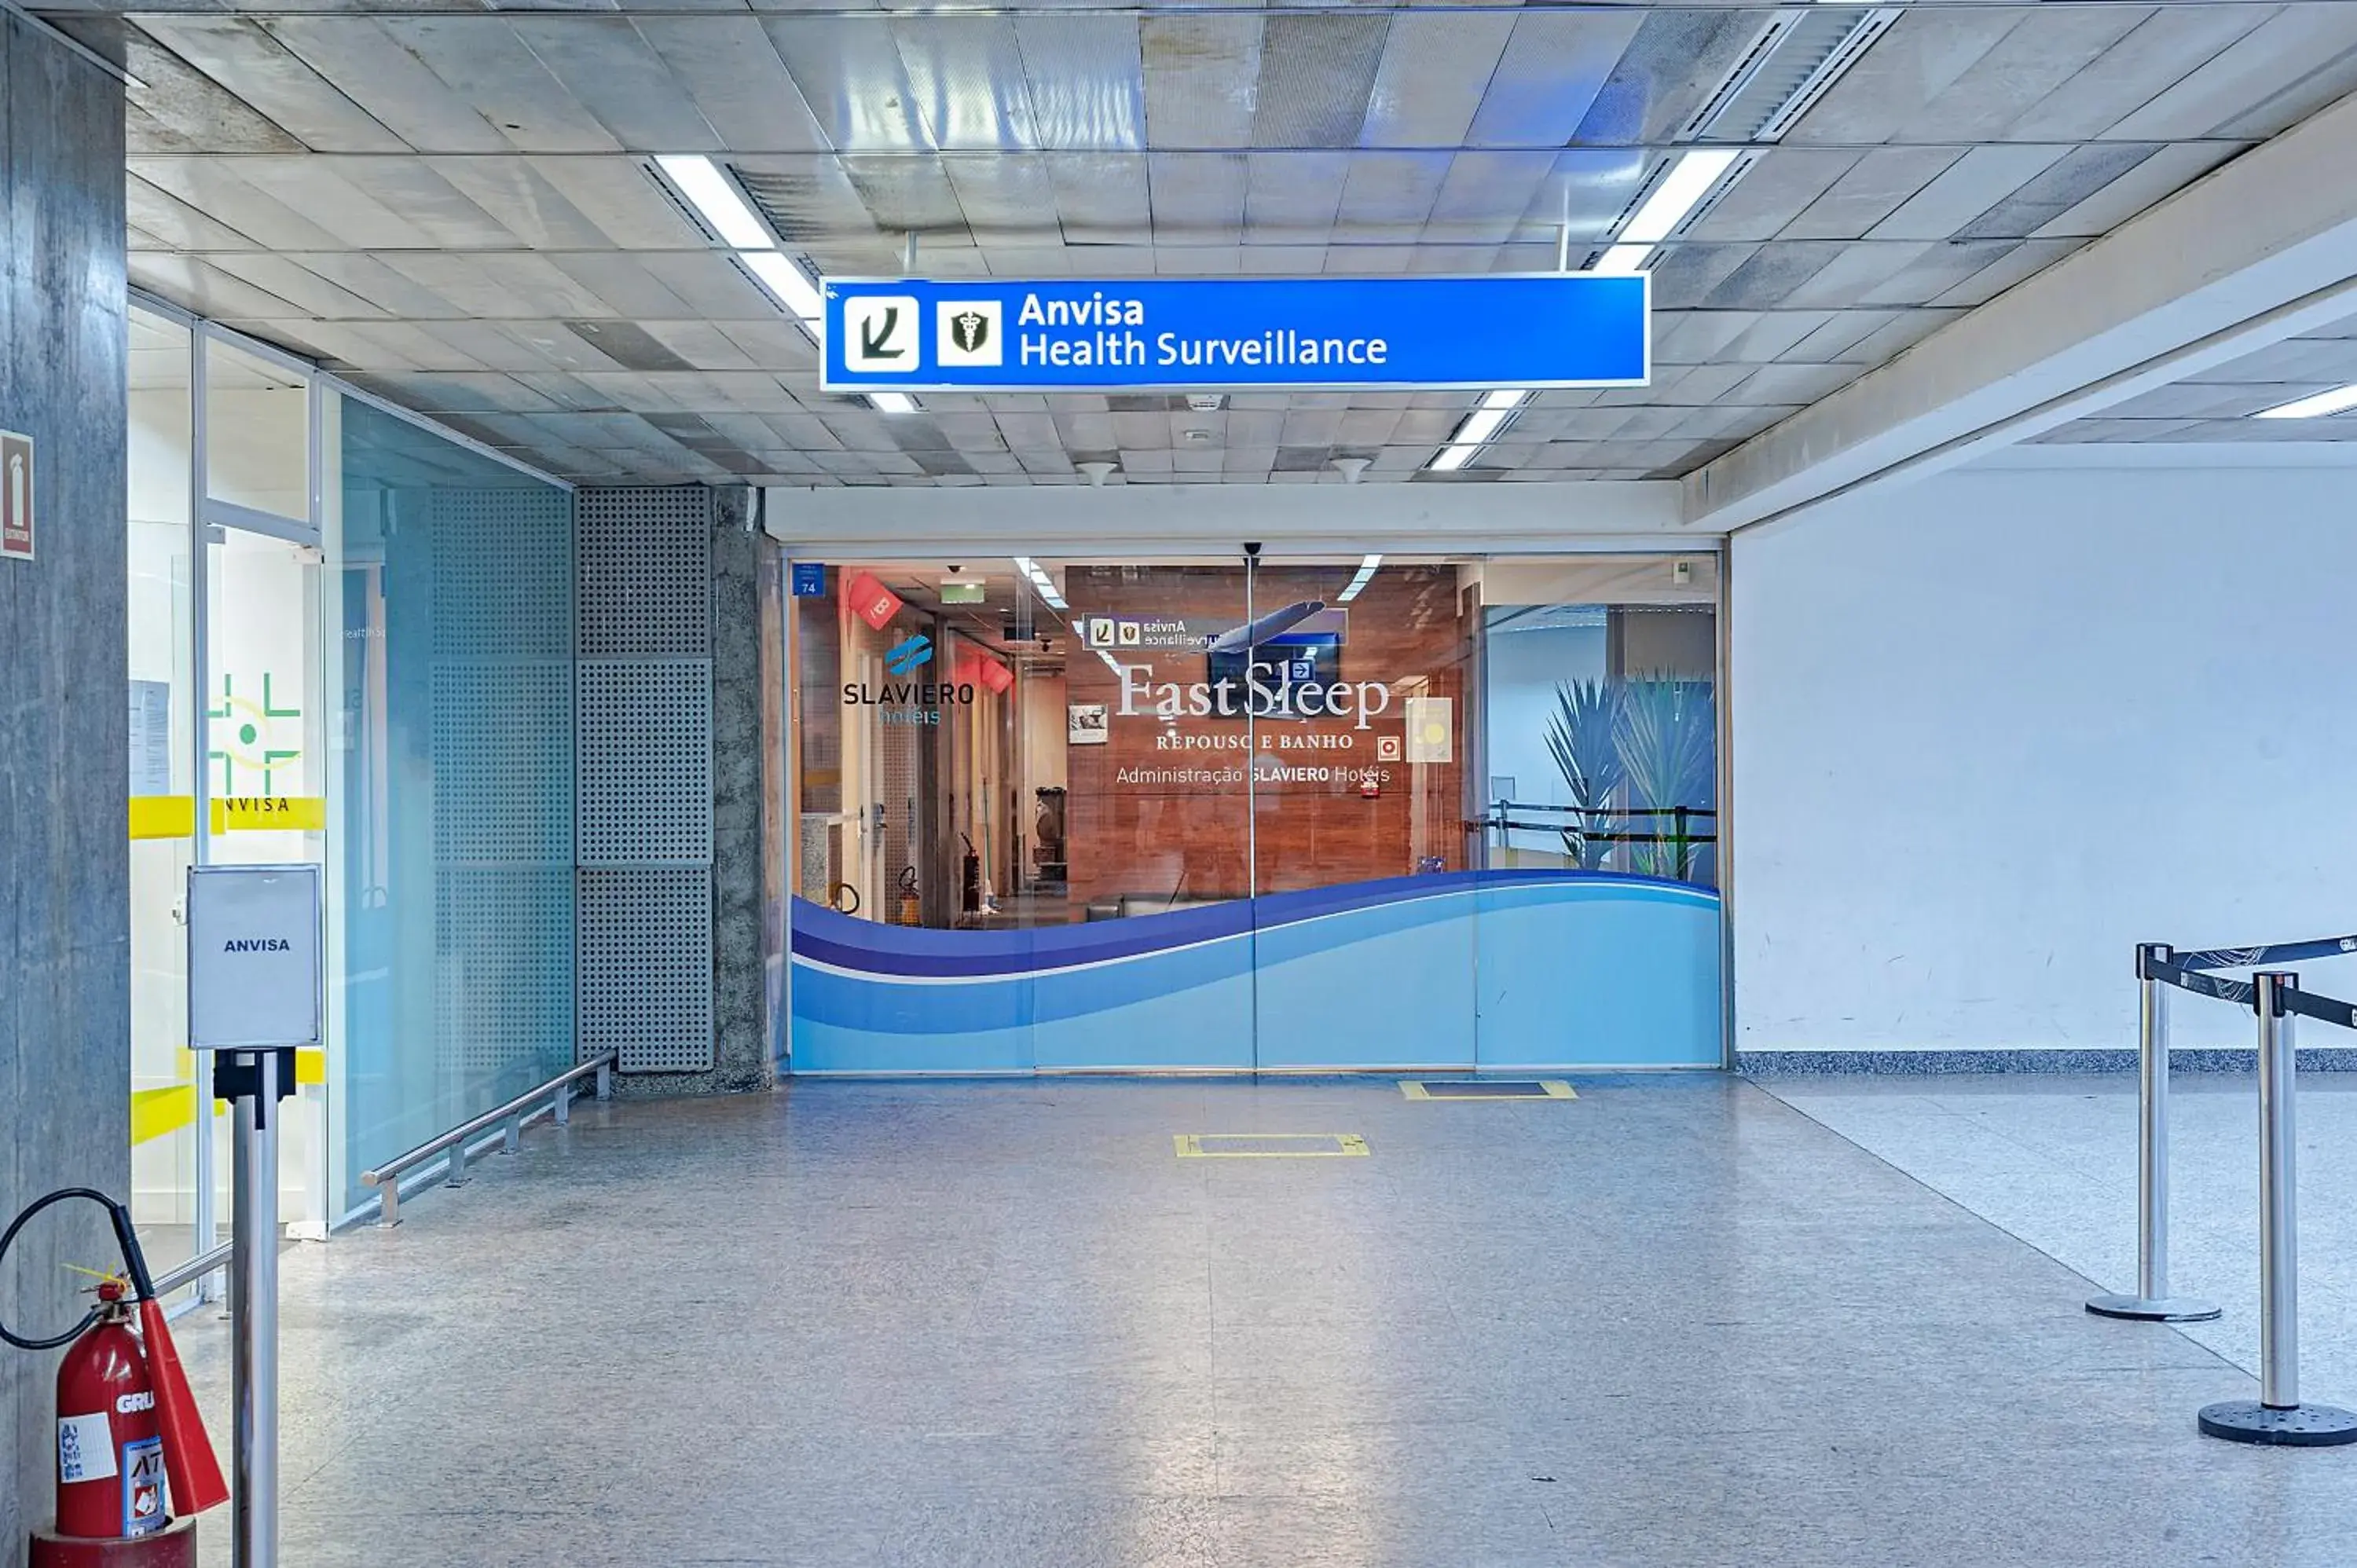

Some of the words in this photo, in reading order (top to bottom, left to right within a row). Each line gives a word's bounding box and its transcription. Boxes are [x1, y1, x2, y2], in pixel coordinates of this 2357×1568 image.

[1018, 292, 1144, 325] Anvisa
[1021, 331, 1146, 365] Health
[1157, 330, 1387, 365] Surveillance
[801, 583, 816, 593] 74
[843, 683, 973, 705] SLAVIERO
[1262, 735, 1272, 749] E
[1280, 735, 1353, 749] BANHO
[1116, 766, 1242, 784] Administração
[1253, 768, 1329, 782] SLAVIERO
[1335, 765, 1391, 782] Hotéis
[224, 939, 290, 953] ANVISA
[116, 1390, 155, 1413] GRU
